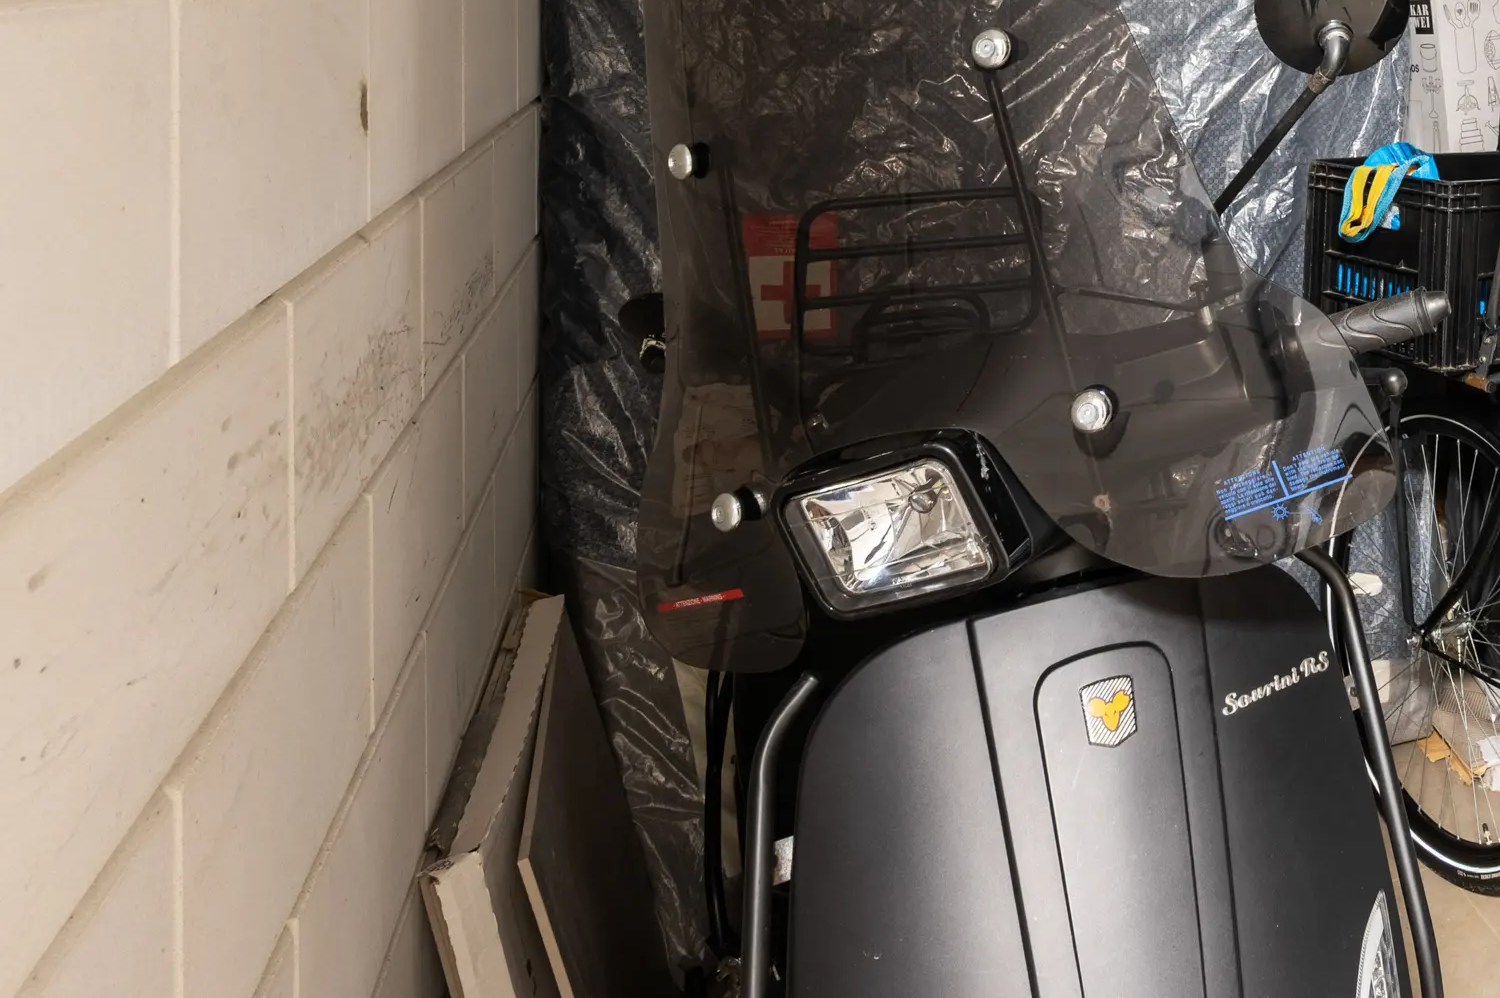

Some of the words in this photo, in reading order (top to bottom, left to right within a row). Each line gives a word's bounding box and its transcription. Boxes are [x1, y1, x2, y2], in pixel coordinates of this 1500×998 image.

[1410, 4, 1429, 16] KAR
[1222, 667, 1301, 718] Sourini
[1300, 650, 1330, 682] RS
